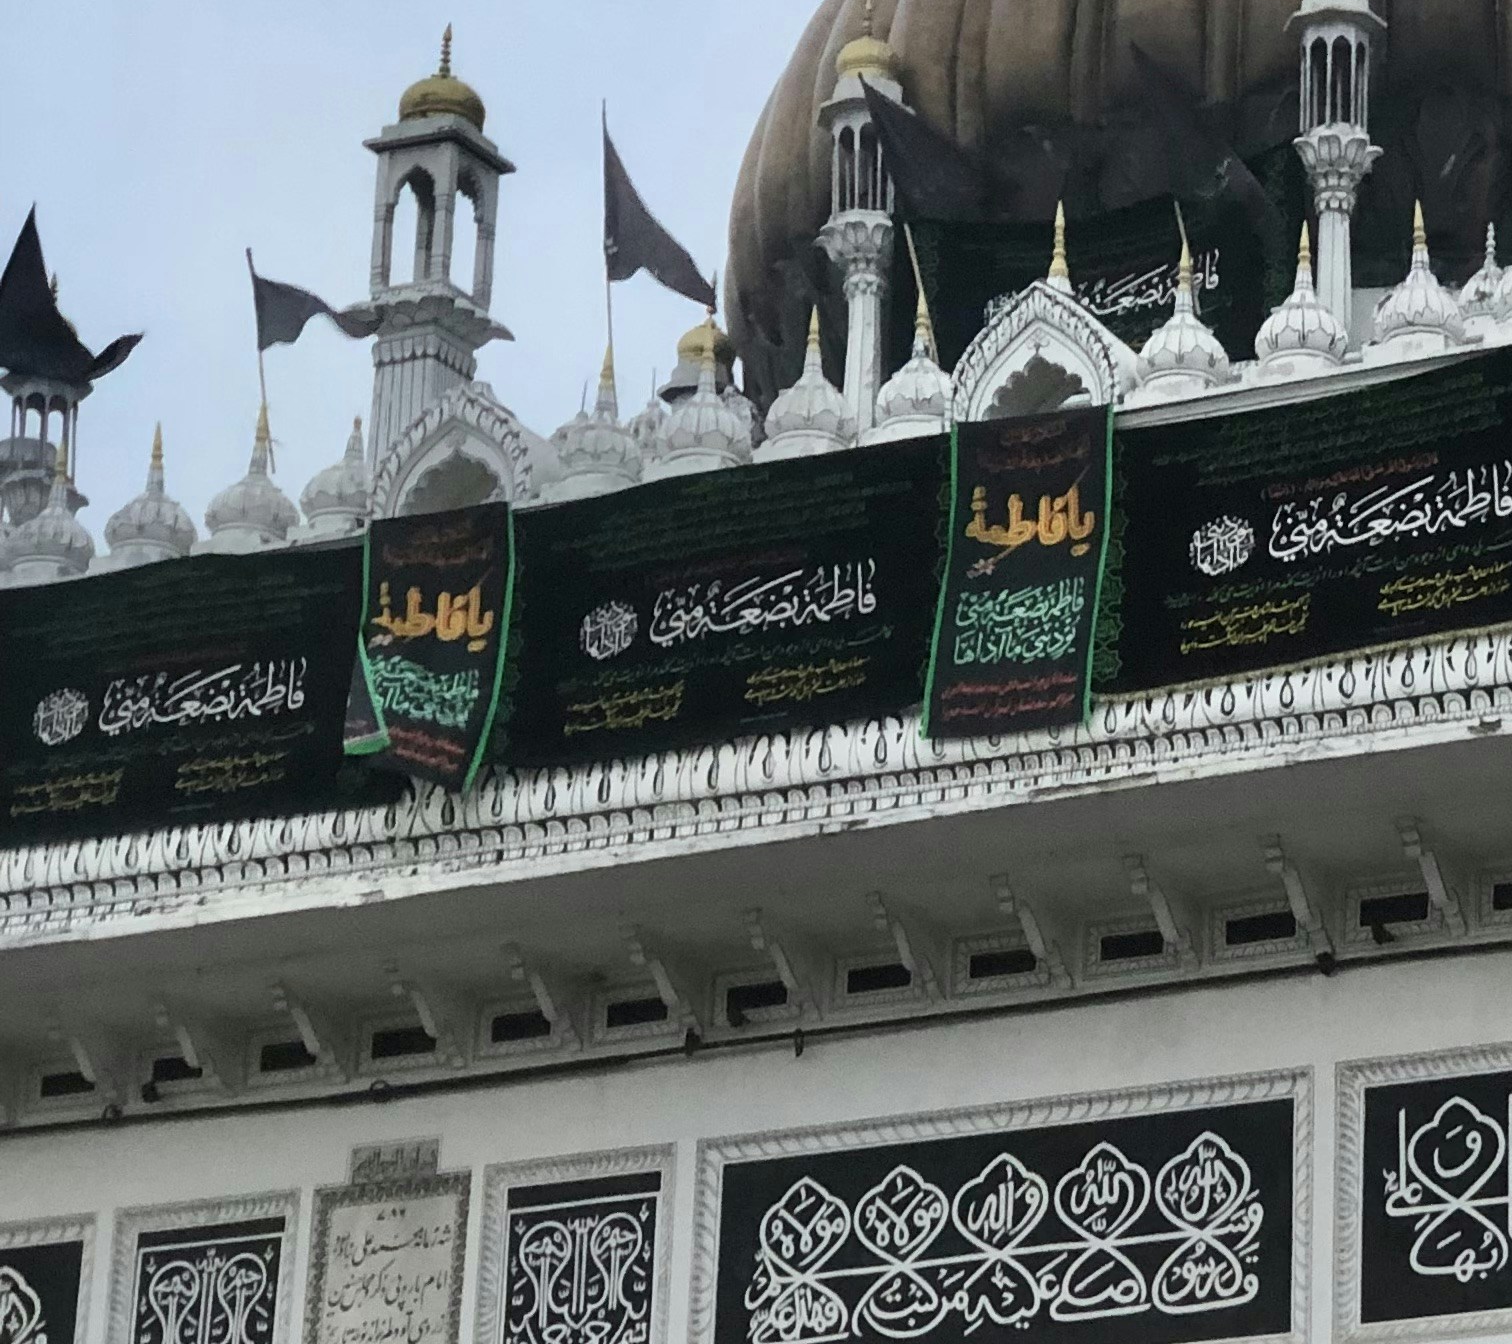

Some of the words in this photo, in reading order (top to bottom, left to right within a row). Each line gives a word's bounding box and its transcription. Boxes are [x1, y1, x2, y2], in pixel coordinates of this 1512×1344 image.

[965, 486, 1068, 546] فاطمة
[1065, 483, 1095, 557] يا
[1268, 497, 1324, 562] مني
[1311, 475, 1435, 552] بضعة
[466, 584, 494, 653] يا
[796, 558, 877, 625] فاطمة
